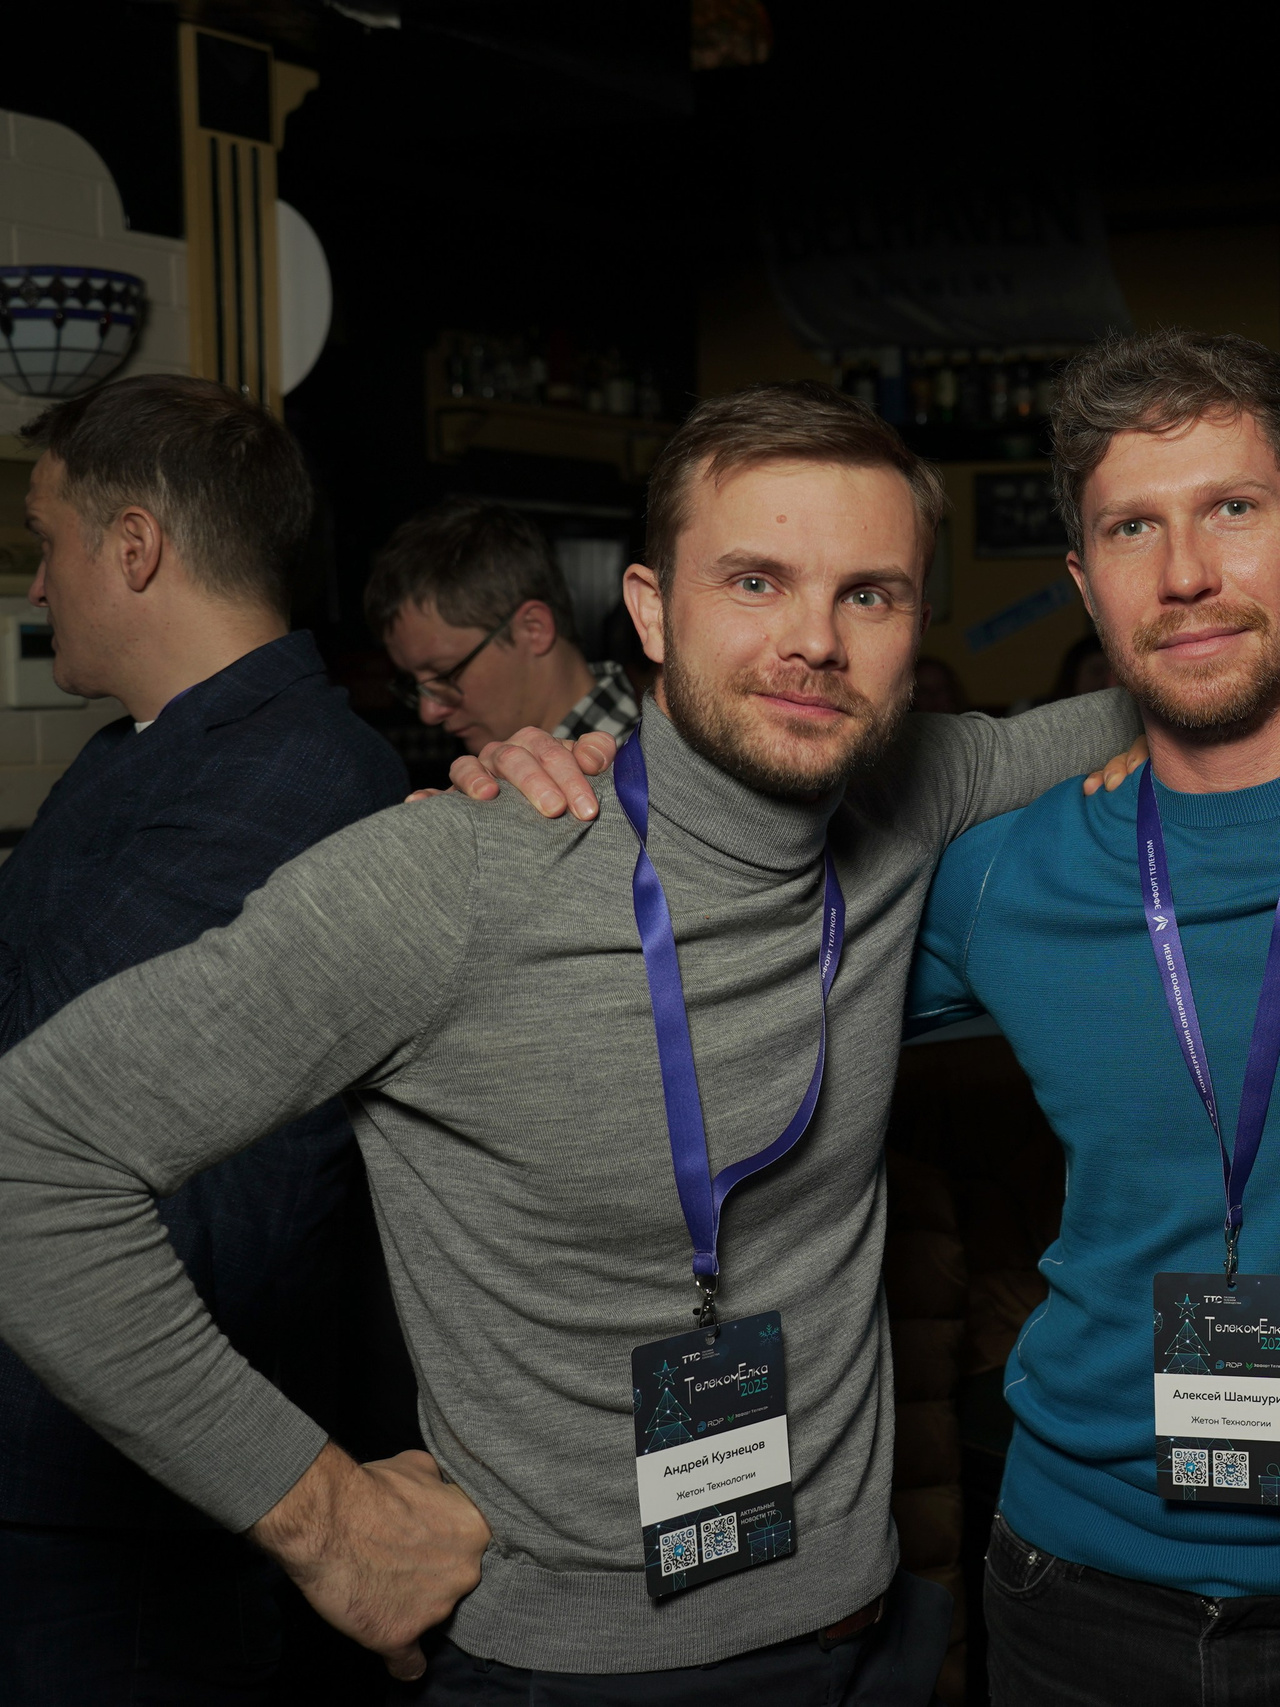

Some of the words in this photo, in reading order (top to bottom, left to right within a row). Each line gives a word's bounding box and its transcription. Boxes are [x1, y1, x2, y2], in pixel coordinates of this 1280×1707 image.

[1146, 839, 1157, 876] ТЕЛЕКОМ
[1150, 877, 1162, 910] ЭФФОРТ
[828, 907, 837, 947] ТЕЛЕКОМ
[1162, 943, 1176, 972] СВЯЗИ
[1170, 972, 1189, 1029] ОПЕРАТОРОВ
[1183, 1029, 1207, 1094] КОНФЕРЕНЦИЯ
[683, 1362, 769, 1405] ТелекомЕлка
[740, 1377, 769, 1397] 2025
[1172, 1389, 1221, 1401] Алексей
[707, 1417, 724, 1428] RDP
[1190, 1416, 1219, 1425] Жетон
[1221, 1417, 1271, 1427] Технологии
[663, 1455, 709, 1478] Андрей
[711, 1441, 766, 1464] Кузнецов
[676, 1487, 705, 1501] Жетон
[706, 1471, 756, 1491] Технологии
[740, 1501, 776, 1517] АКТУАЛЬНЫЕ
[741, 1513, 767, 1525] НОВОСТИ
[767, 1509, 777, 1517] ТТС
